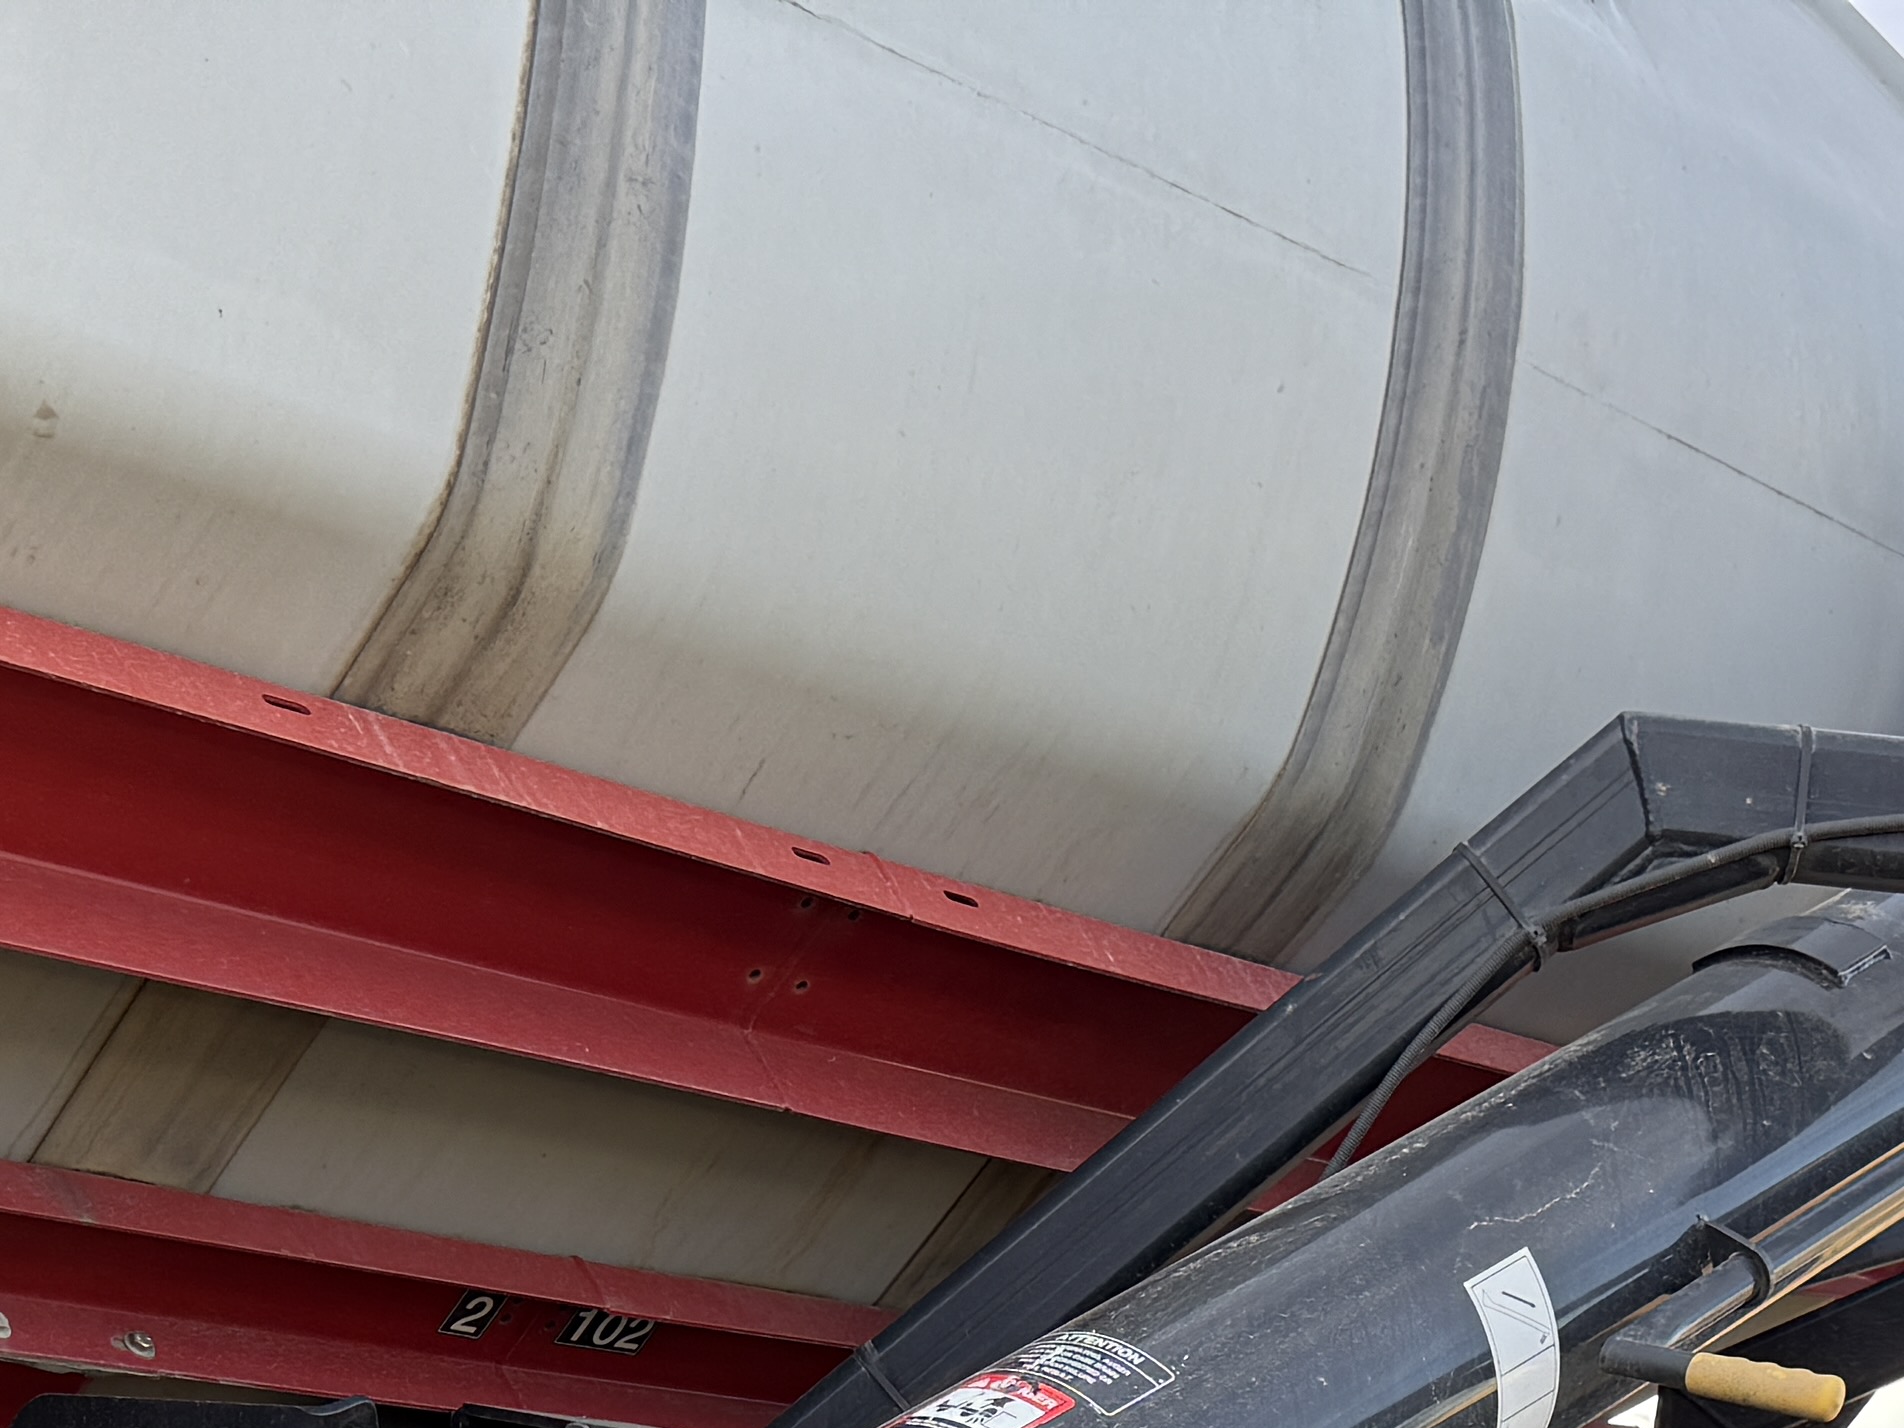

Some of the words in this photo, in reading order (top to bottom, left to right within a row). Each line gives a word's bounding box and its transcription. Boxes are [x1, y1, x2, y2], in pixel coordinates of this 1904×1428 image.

[450, 1296, 494, 1334] 2
[570, 1308, 656, 1351] 102
[1056, 1333, 1146, 1365] ATTENTION
